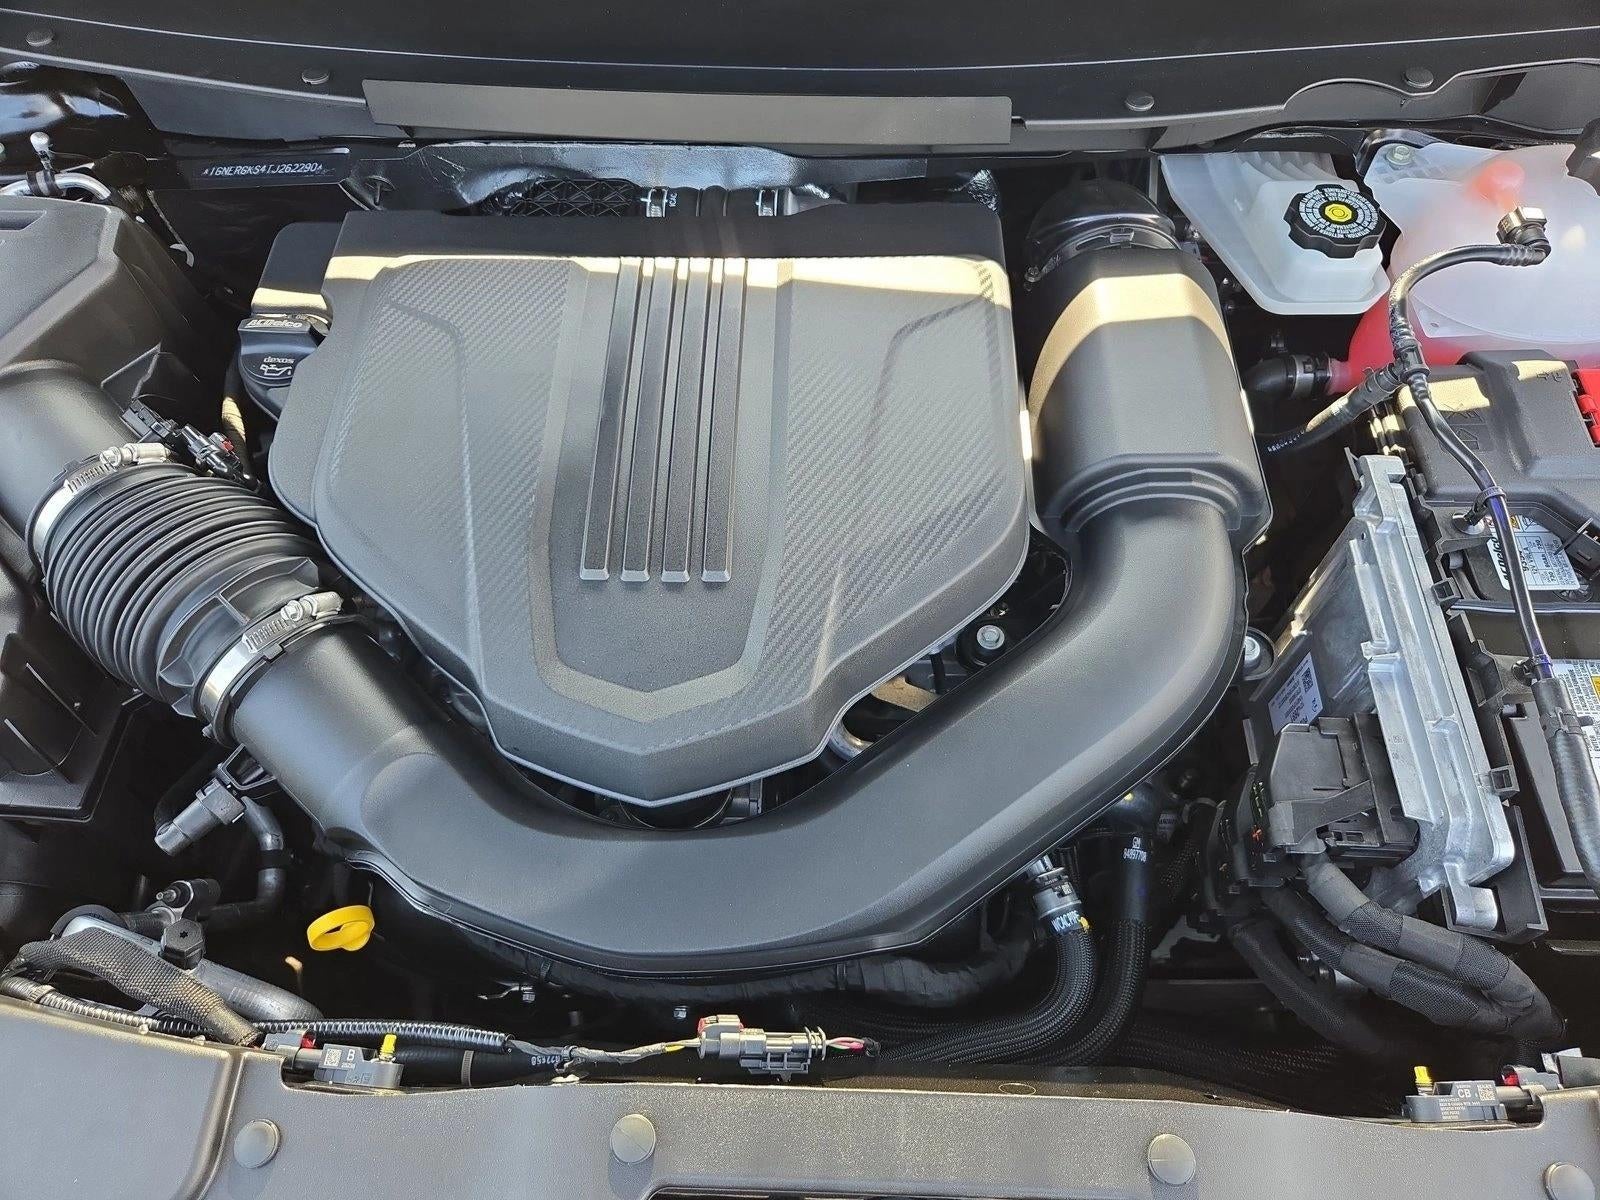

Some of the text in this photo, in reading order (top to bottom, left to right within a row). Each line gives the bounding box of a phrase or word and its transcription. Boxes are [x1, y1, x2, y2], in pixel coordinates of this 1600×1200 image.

[263, 356, 295, 364] dexos
[347, 1049, 355, 1061] B
[1458, 1089, 1471, 1098] CB
